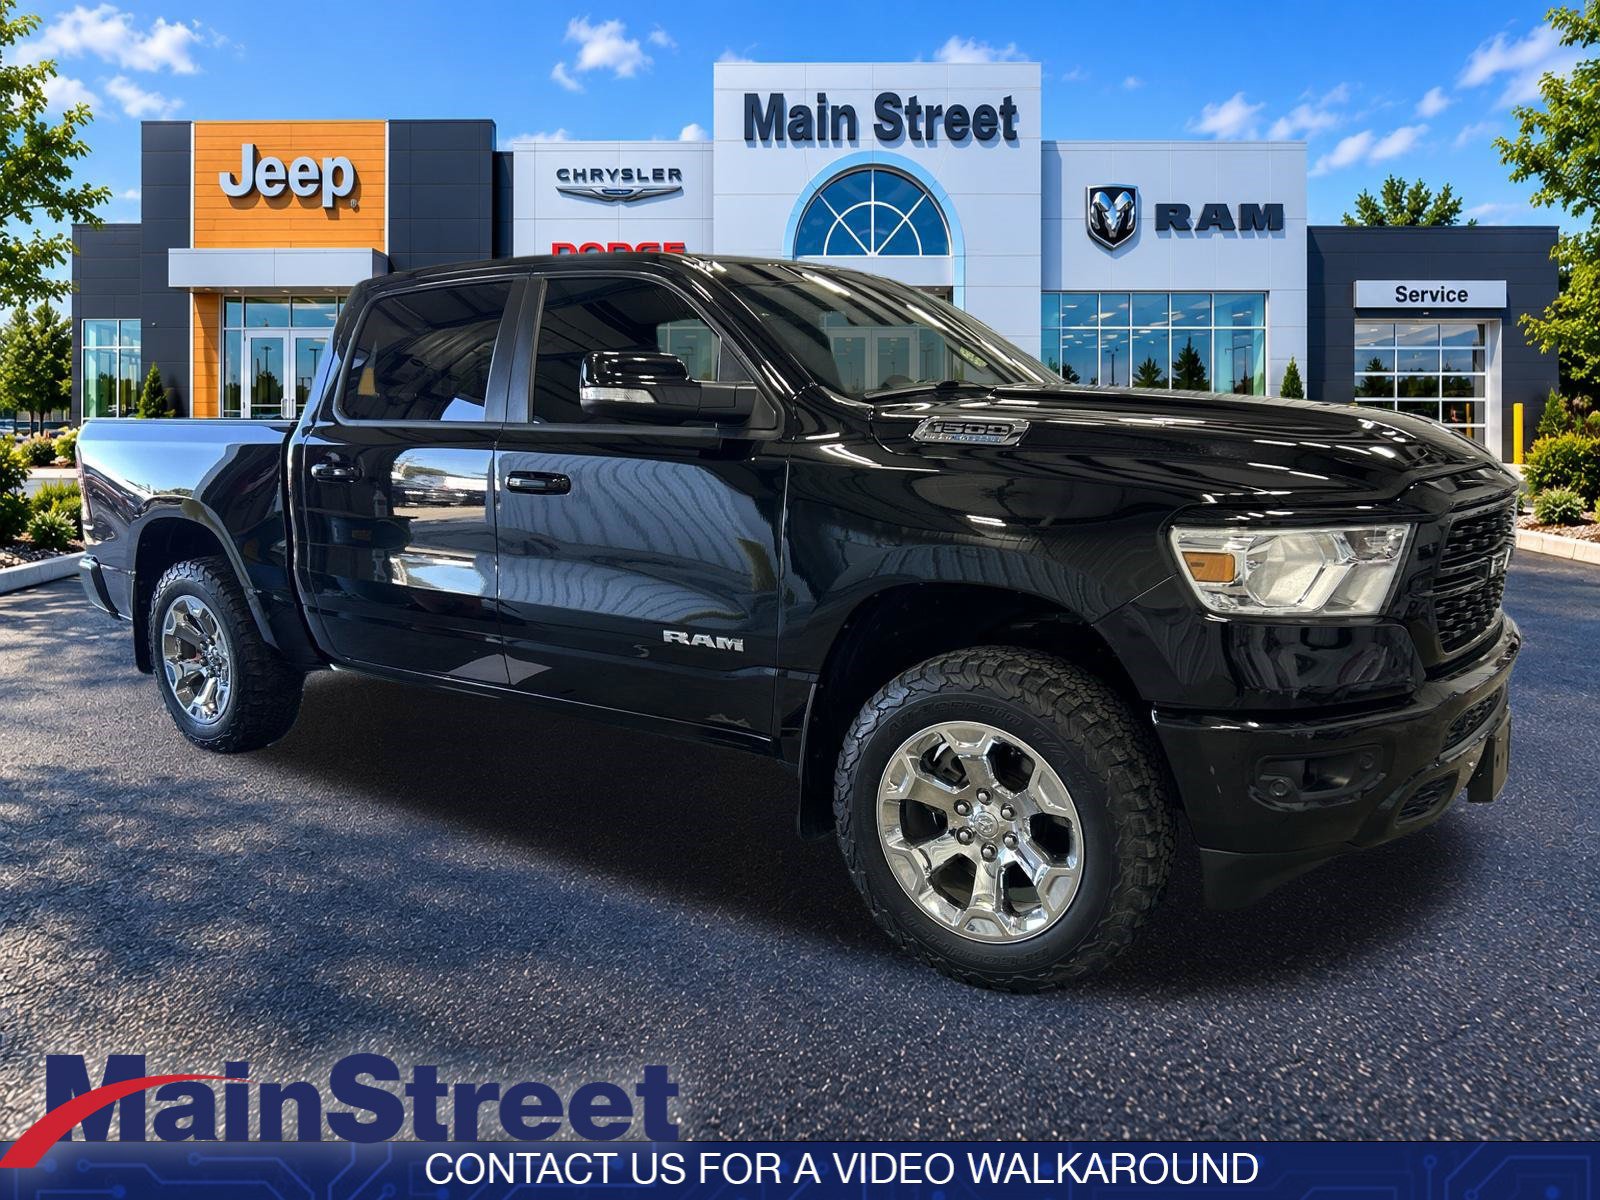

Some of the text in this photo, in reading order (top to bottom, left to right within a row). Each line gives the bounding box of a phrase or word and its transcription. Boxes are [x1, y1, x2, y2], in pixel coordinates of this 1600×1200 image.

[744, 92, 1017, 141] Main Street
[219, 143, 354, 208] Jeep
[556, 168, 682, 182] CHRYSLER
[1155, 203, 1284, 231] RAM
[1395, 285, 1469, 303] Service
[933, 421, 1010, 435] 1500
[663, 629, 744, 652] RAM
